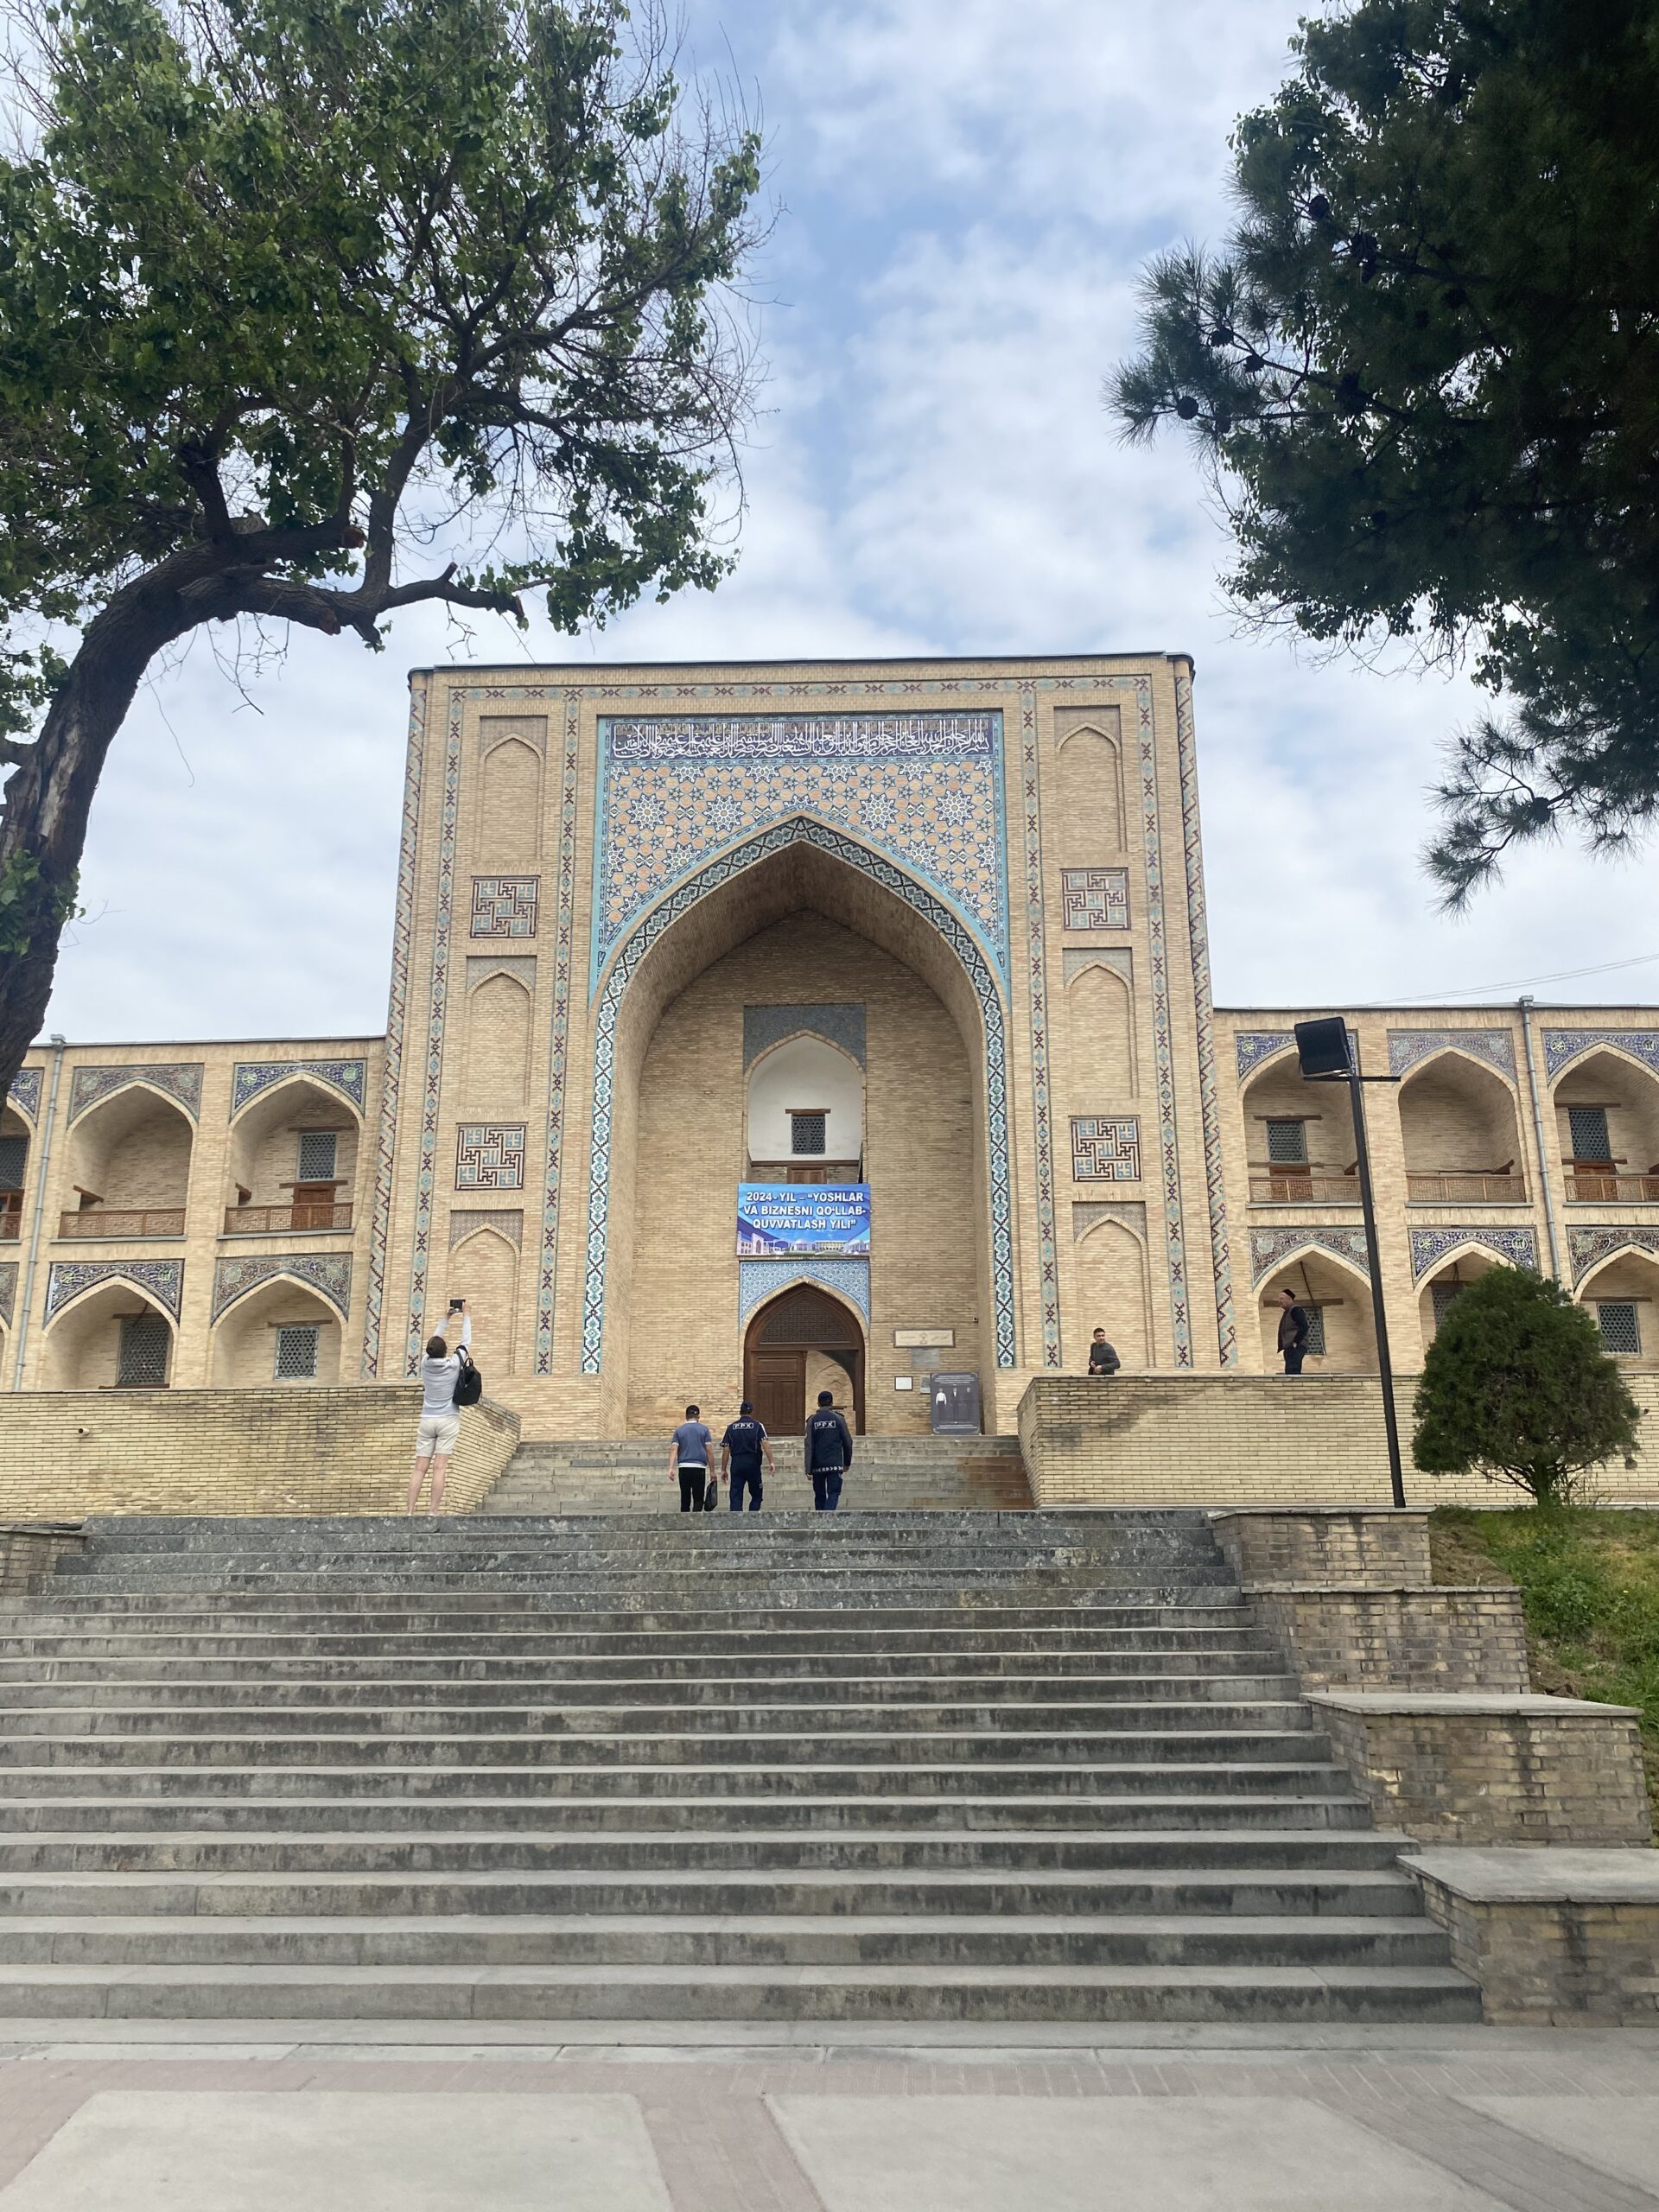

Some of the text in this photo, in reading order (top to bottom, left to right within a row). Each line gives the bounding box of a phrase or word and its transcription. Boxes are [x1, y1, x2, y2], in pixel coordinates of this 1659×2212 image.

[743, 1205, 759, 1215] VA
[761, 1205, 813, 1215] BIZNESNI
[753, 1219, 826, 1230] QUVVATLASH
